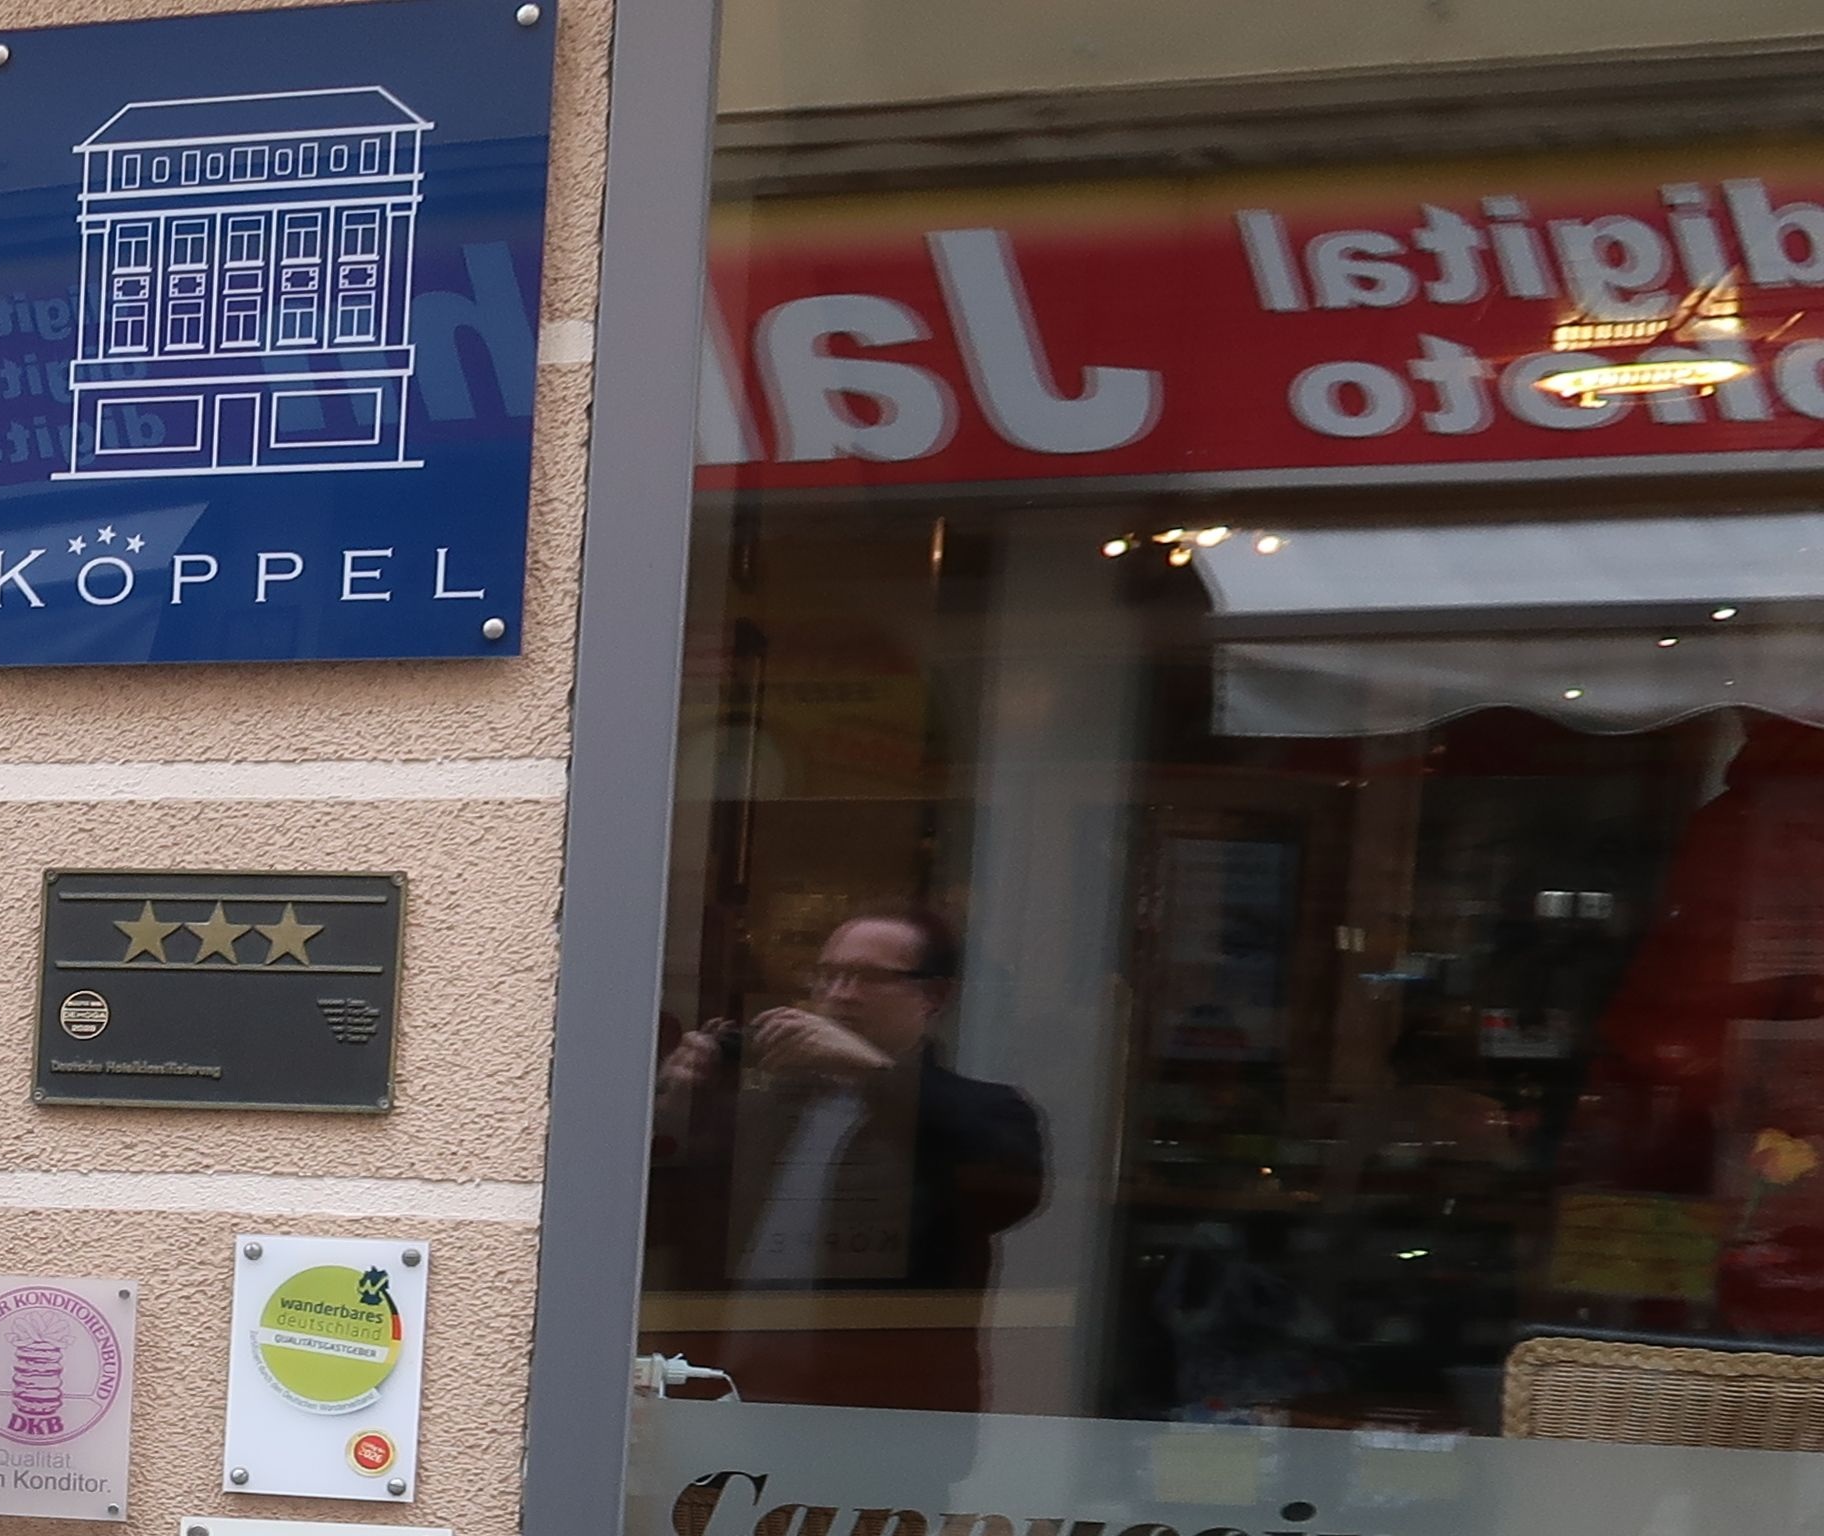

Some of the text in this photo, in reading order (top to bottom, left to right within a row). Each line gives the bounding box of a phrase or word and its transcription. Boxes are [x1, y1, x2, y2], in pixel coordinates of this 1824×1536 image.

[280, 1297, 384, 1324] wanderbares
[276, 1313, 383, 1341] deutschland
[13, 1291, 117, 1401] KONDITORENBUND
[7, 1413, 64, 1435] DKB
[14, 1470, 111, 1493] Konditor.
